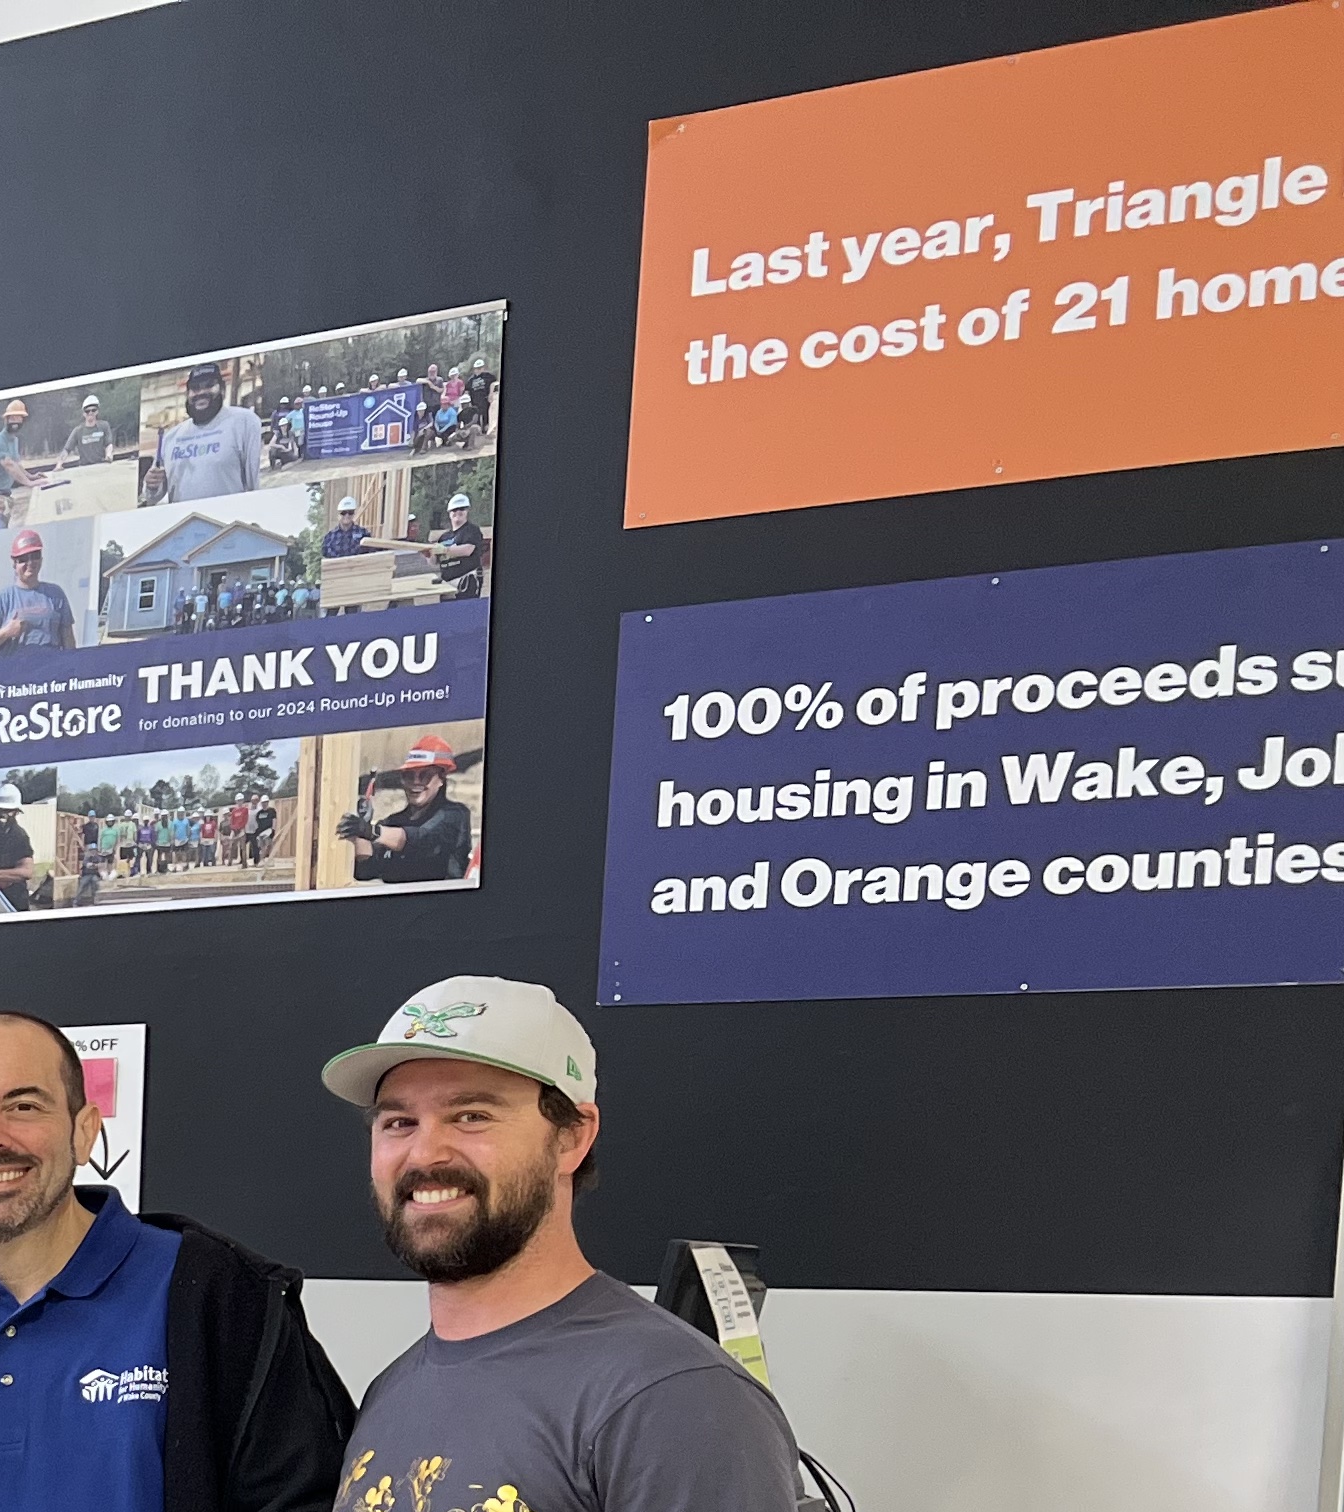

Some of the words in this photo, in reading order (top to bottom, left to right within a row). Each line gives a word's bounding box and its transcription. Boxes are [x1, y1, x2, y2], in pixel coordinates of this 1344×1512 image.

[690, 231, 831, 298] Last
[841, 212, 1013, 286] year,
[1026, 156, 1329, 244] Triangle
[684, 333, 789, 387] the
[799, 305, 946, 369] cost
[958, 289, 1031, 347] of
[1051, 276, 1130, 334] 21
[172, 442, 220, 459] ReStore
[8, 682, 48, 698] Habitat
[50, 680, 67, 693] for
[69, 674, 125, 691] Humanity
[138, 647, 314, 703] THANK
[326, 632, 438, 683] YOU
[662, 682, 845, 741] 100%
[856, 671, 927, 726] of
[935, 644, 1279, 730] proceeds
[139, 718, 158, 731] for
[162, 710, 225, 729] donating
[229, 709, 244, 721] to
[248, 708, 271, 720] our
[277, 701, 315, 717] 2024
[321, 693, 396, 712] Round-Up
[400, 685, 450, 704] Home!
[656, 768, 914, 829] housing
[925, 760, 987, 812] in
[1001, 746, 1226, 806] Wake,
[1237, 732, 1344, 790] Jo
[650, 860, 770, 915] and
[780, 857, 1032, 911] Orange
[89, 1038, 119, 1051] OFF
[119, 1365, 169, 1386] Habitat
